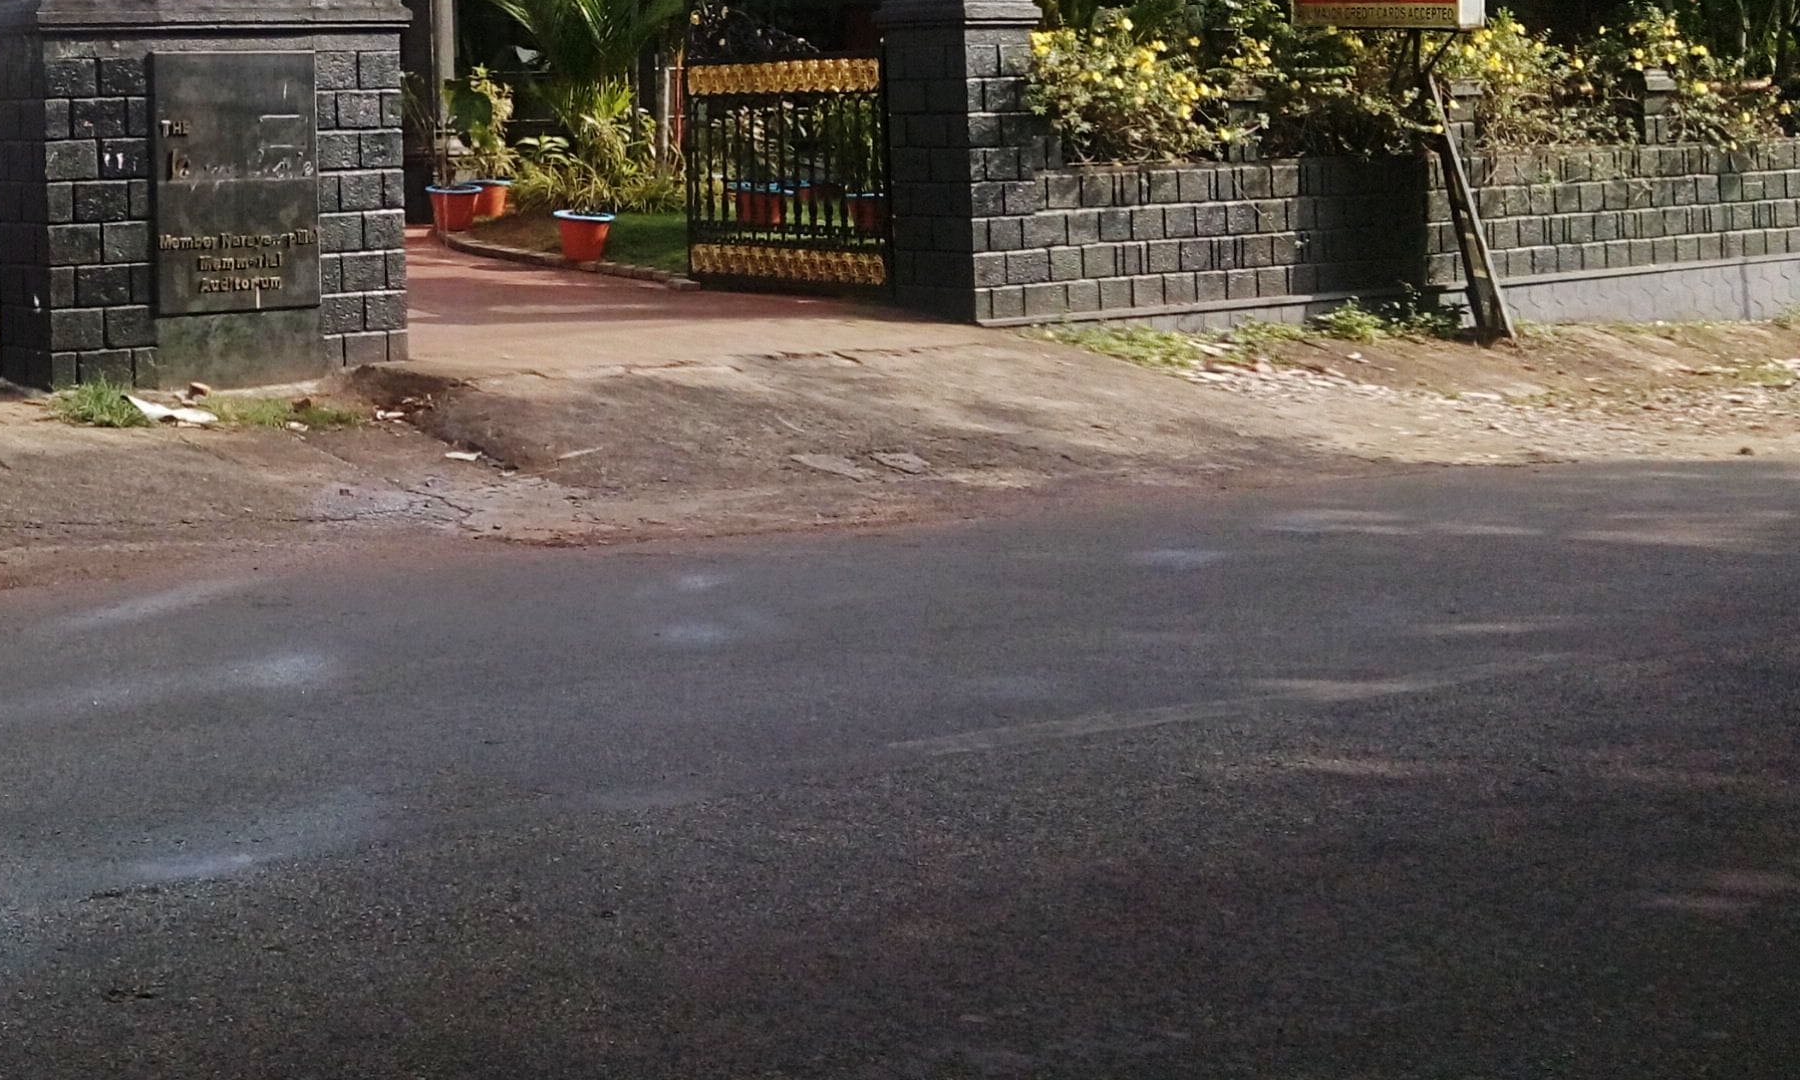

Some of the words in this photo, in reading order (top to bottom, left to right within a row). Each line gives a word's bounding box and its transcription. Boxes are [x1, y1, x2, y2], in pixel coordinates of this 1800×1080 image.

[1376, 7, 1406, 20] CARDS
[1408, 7, 1455, 20] ACCEPTED
[161, 119, 192, 138] THE
[159, 234, 218, 250] Member
